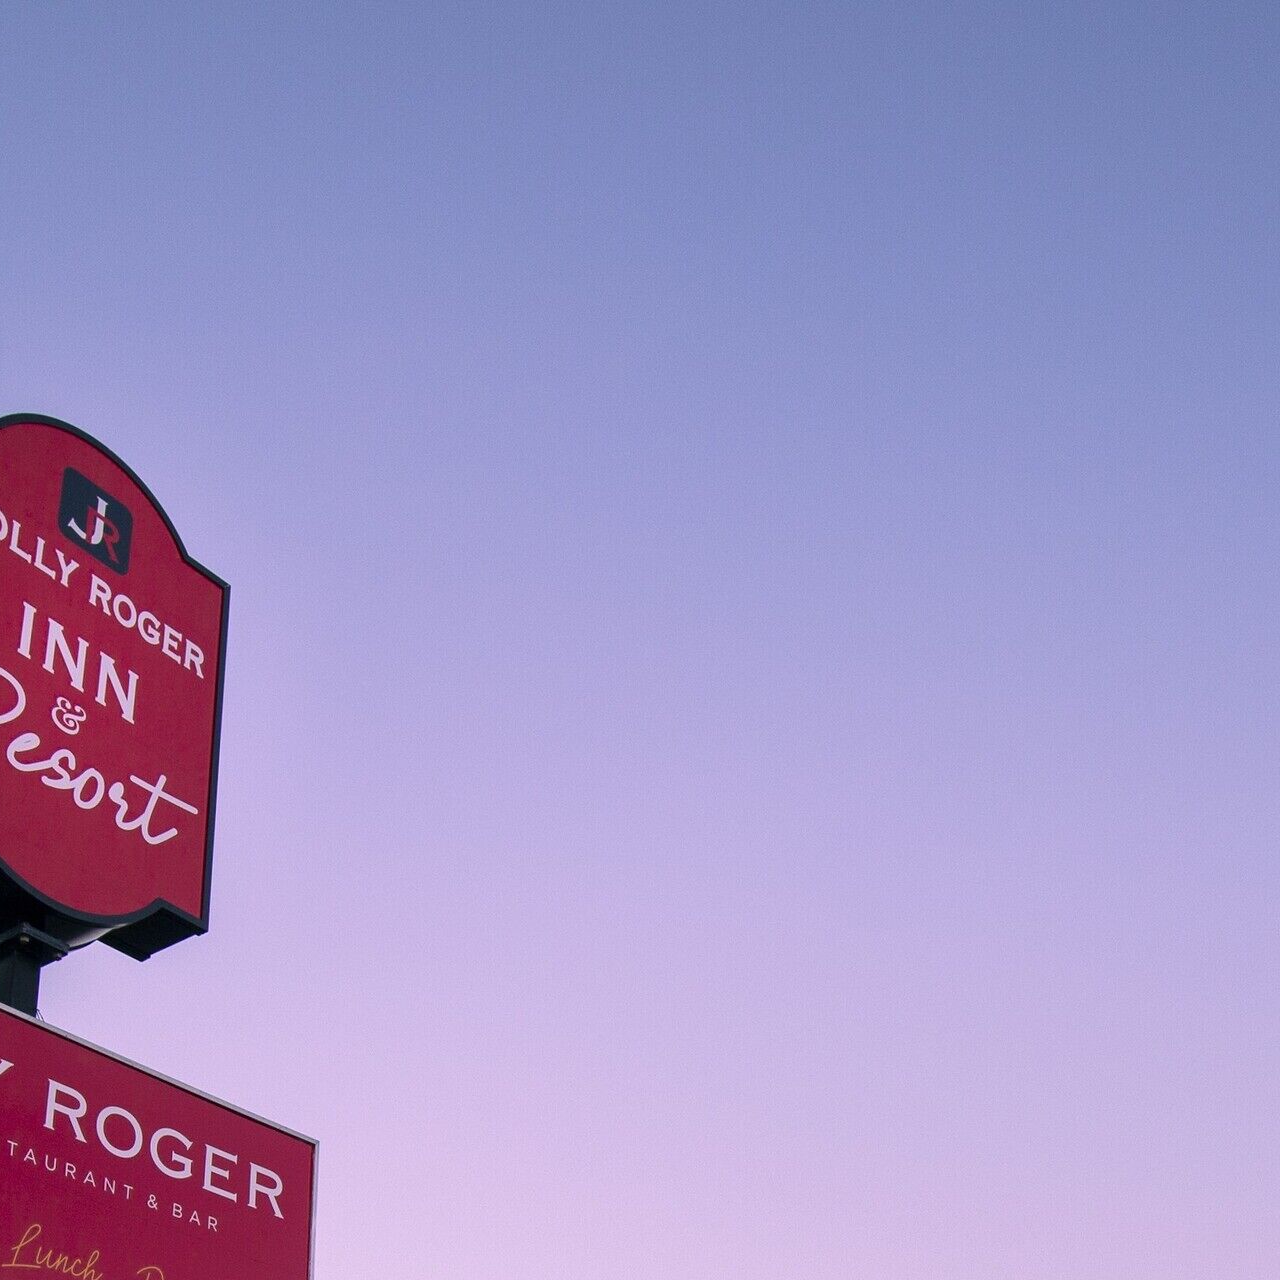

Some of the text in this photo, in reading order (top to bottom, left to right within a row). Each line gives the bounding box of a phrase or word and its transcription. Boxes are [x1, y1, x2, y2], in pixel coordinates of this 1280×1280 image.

[17, 601, 139, 724] INN
[89, 574, 205, 679] ROGER
[52, 696, 87, 735] &
[43, 1078, 286, 1219] ROGER
[147, 1194, 159, 1210] &
[172, 1193, 219, 1232] BAR
